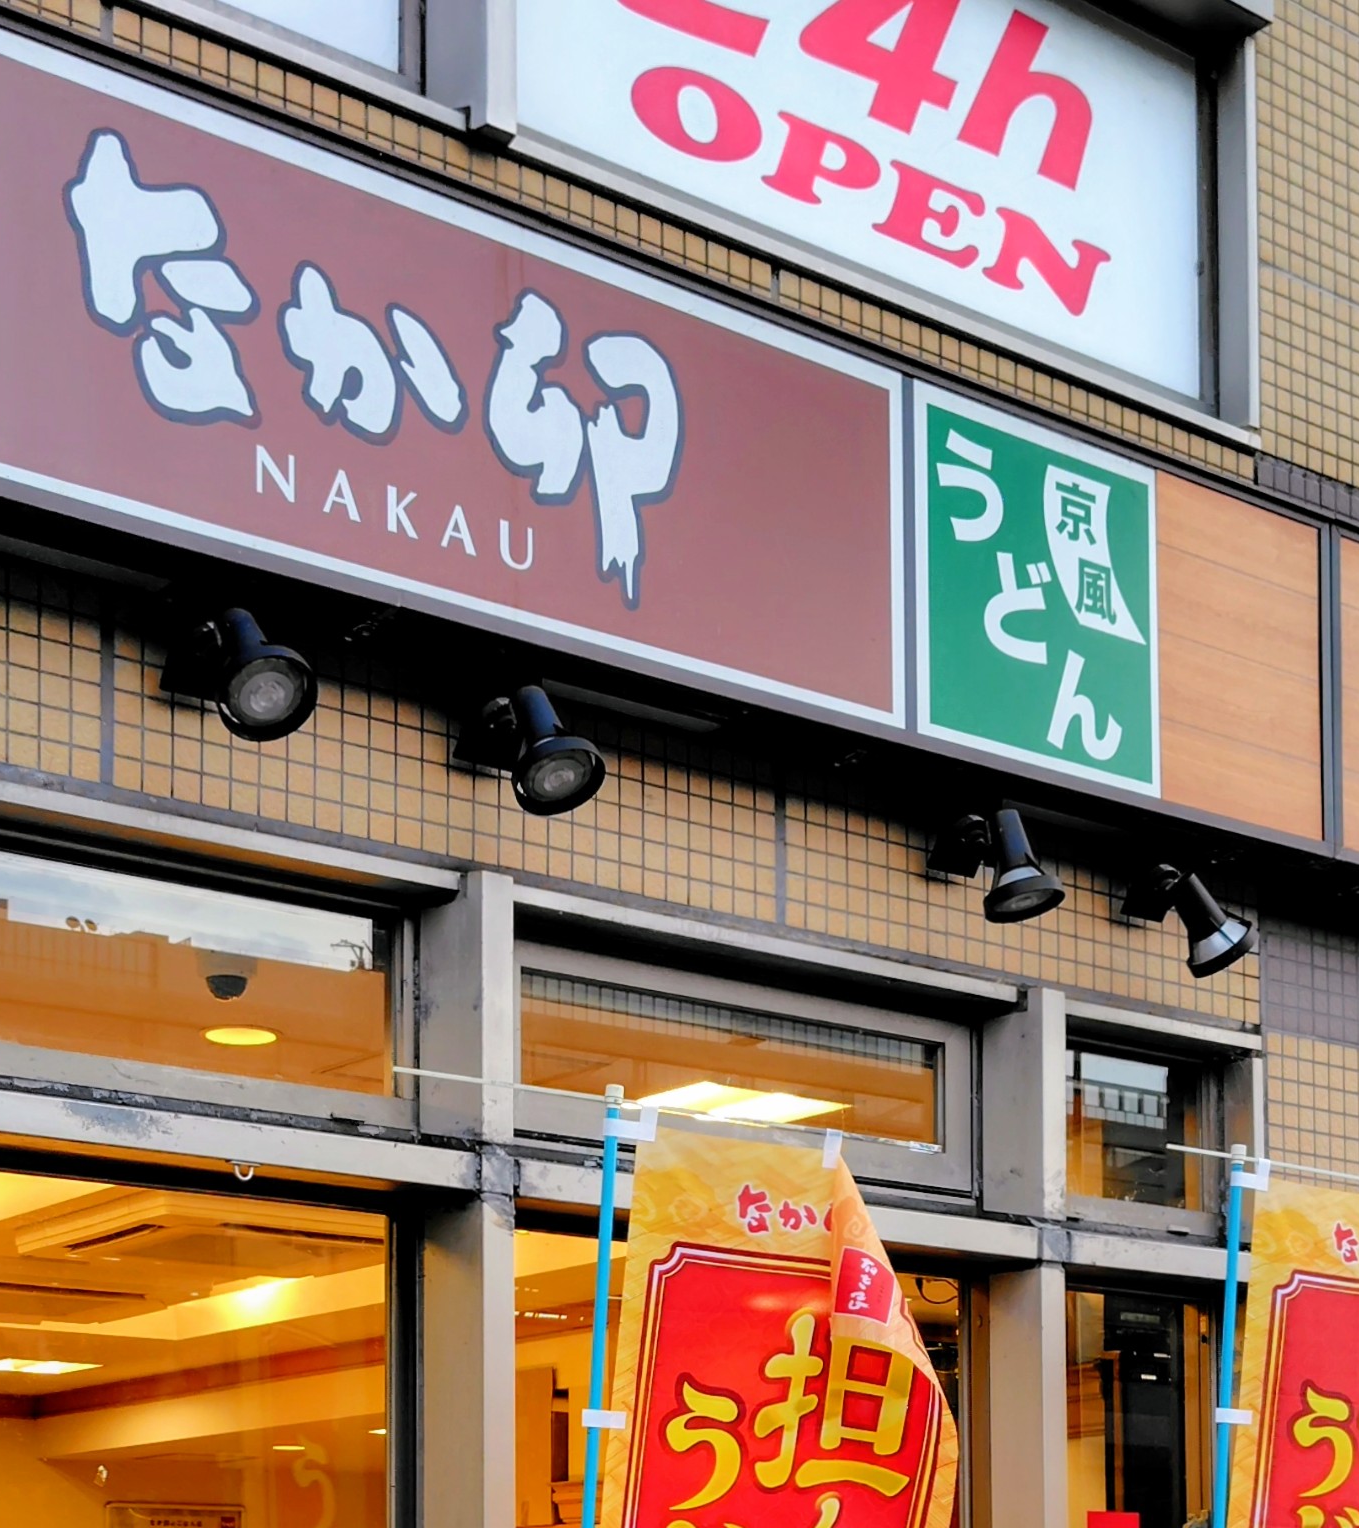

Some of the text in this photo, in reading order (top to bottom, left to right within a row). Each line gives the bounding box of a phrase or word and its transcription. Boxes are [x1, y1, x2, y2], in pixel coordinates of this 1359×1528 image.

[630, 66, 1111, 316] OPEN
[66, 130, 681, 606] なか卯
[255, 444, 535, 572] NAKAU
[937, 429, 1122, 760] うどん
[1055, 482, 1118, 626] 京風
[737, 1184, 834, 1234] なか
